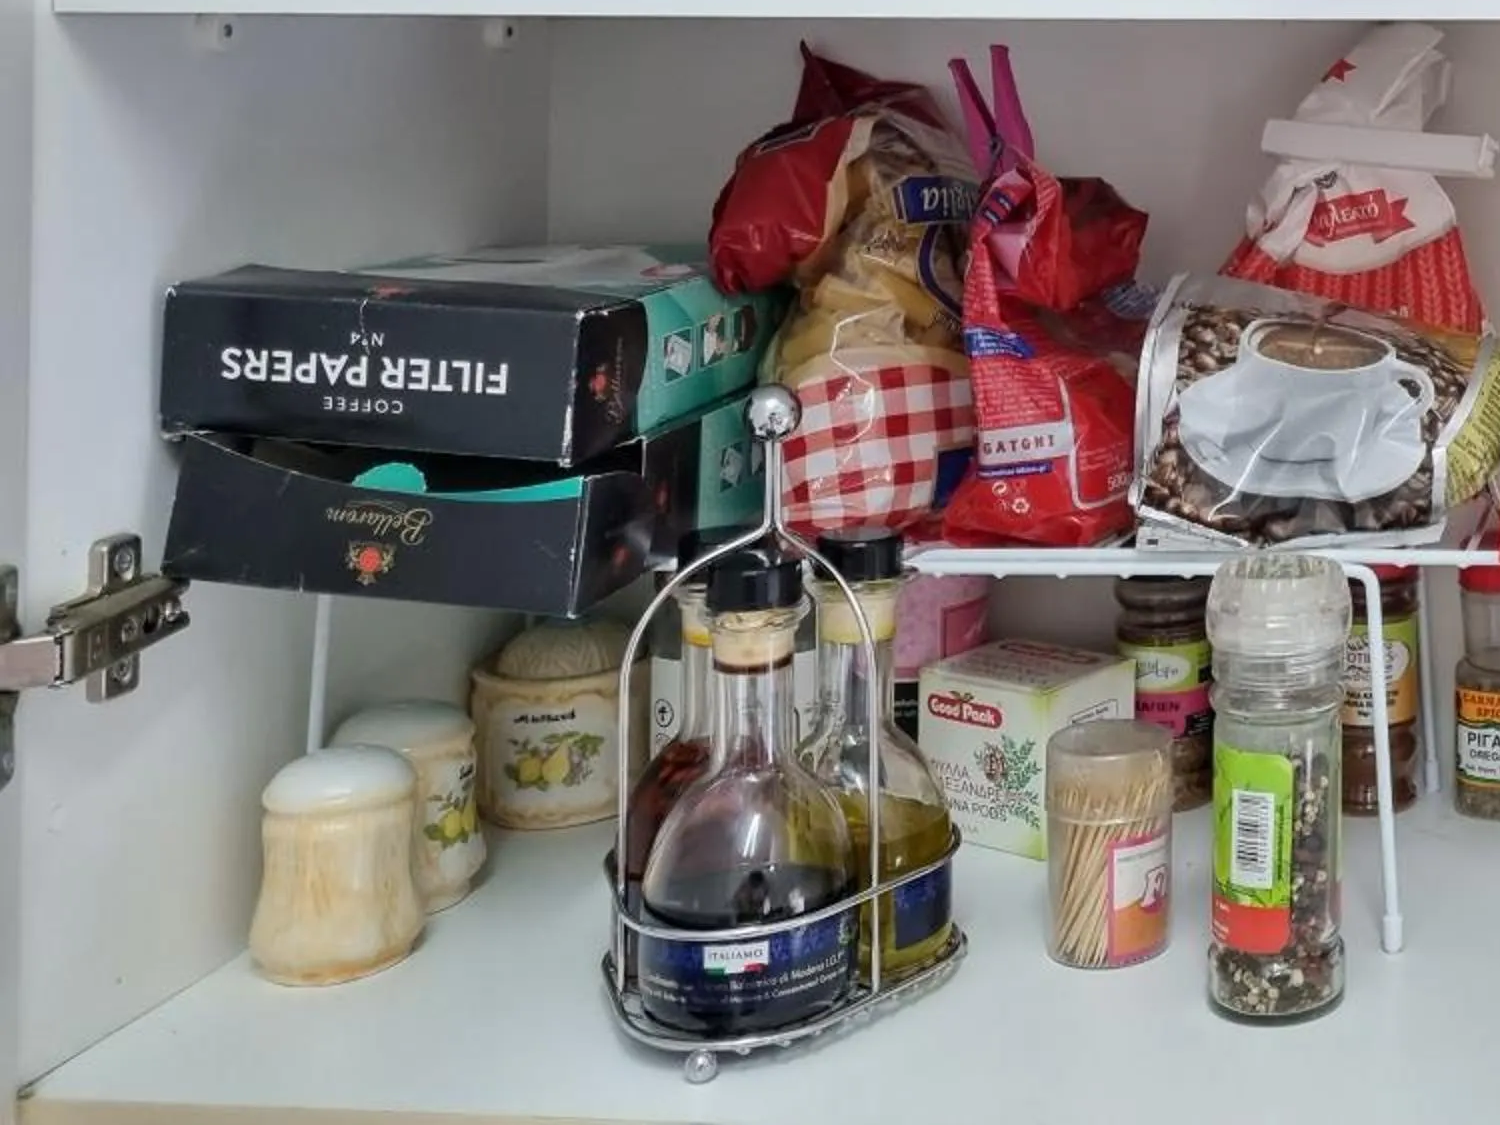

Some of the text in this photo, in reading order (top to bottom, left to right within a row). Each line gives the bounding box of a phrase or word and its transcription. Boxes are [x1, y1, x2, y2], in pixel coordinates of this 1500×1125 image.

[220, 345, 510, 396] FILTER PAPERS
[323, 394, 404, 415] COFFEE
[324, 501, 435, 546] Bellarom
[929, 696, 997, 726] Good Pack
[708, 948, 764, 963] ITALIAMO
